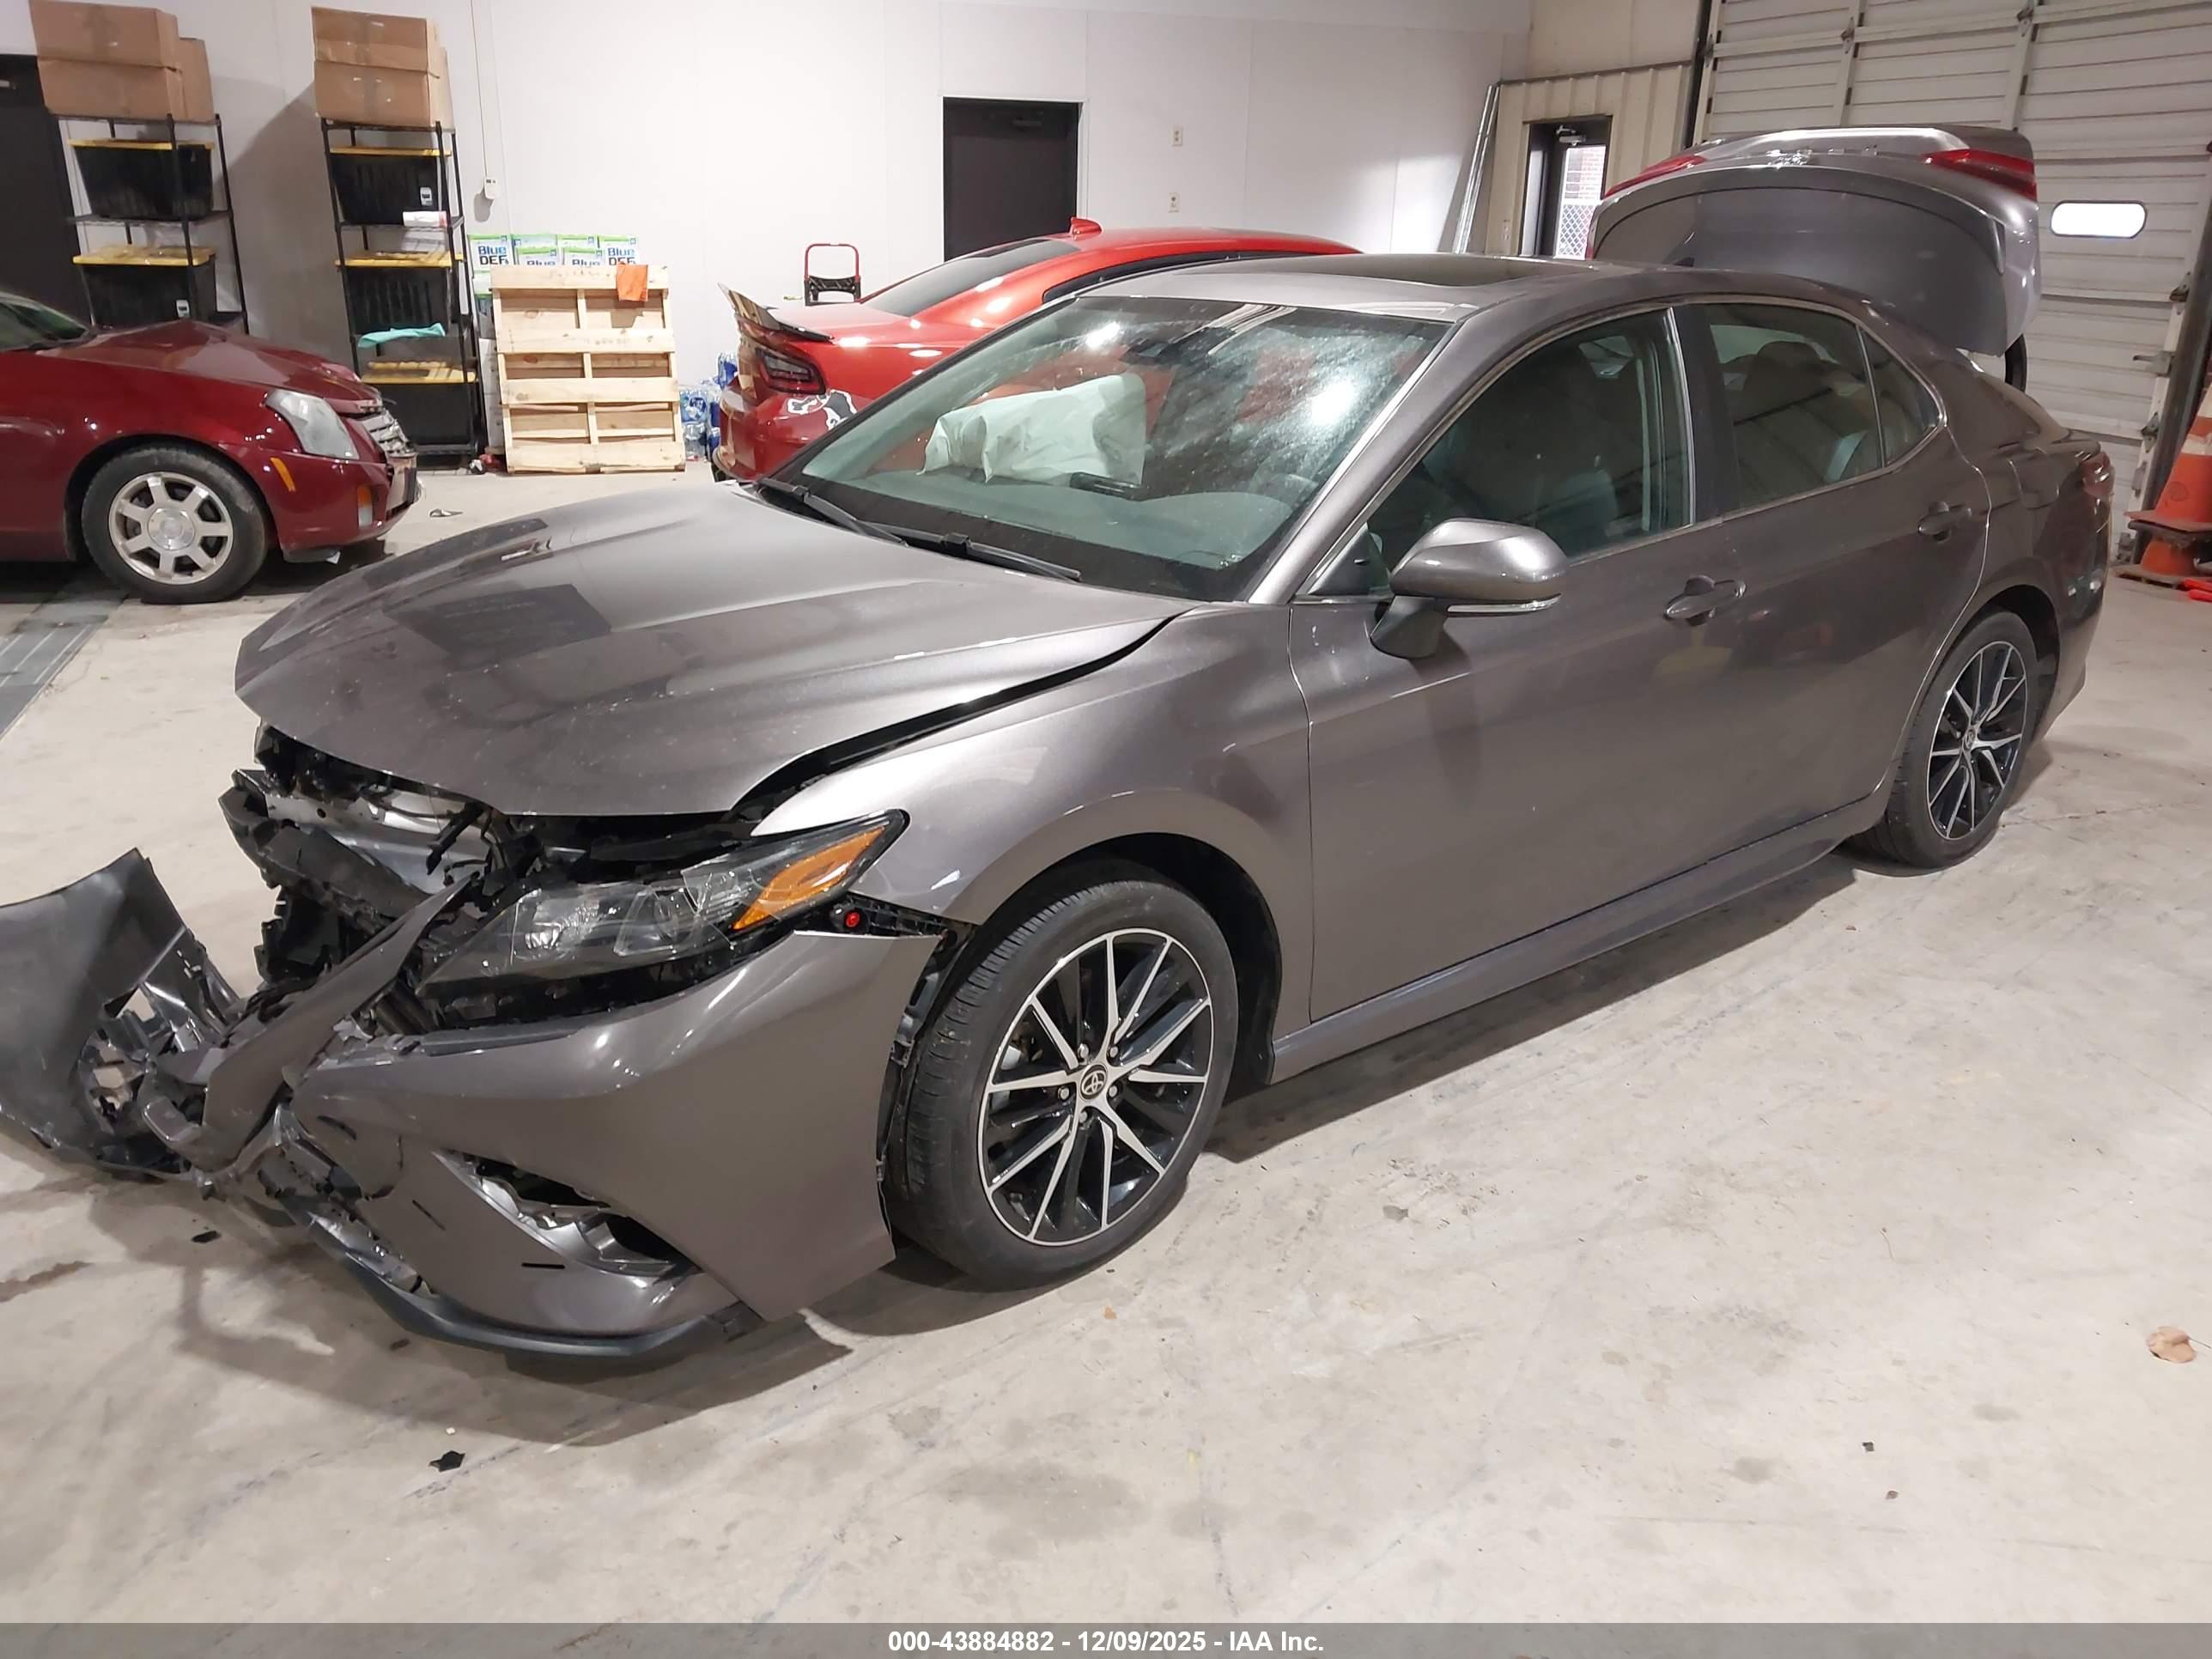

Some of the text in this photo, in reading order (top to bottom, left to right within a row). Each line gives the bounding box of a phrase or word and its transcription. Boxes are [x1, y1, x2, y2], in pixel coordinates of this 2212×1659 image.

[477, 246, 507, 255] Blue
[607, 247, 635, 257] Blue
[479, 255, 508, 265] DEF
